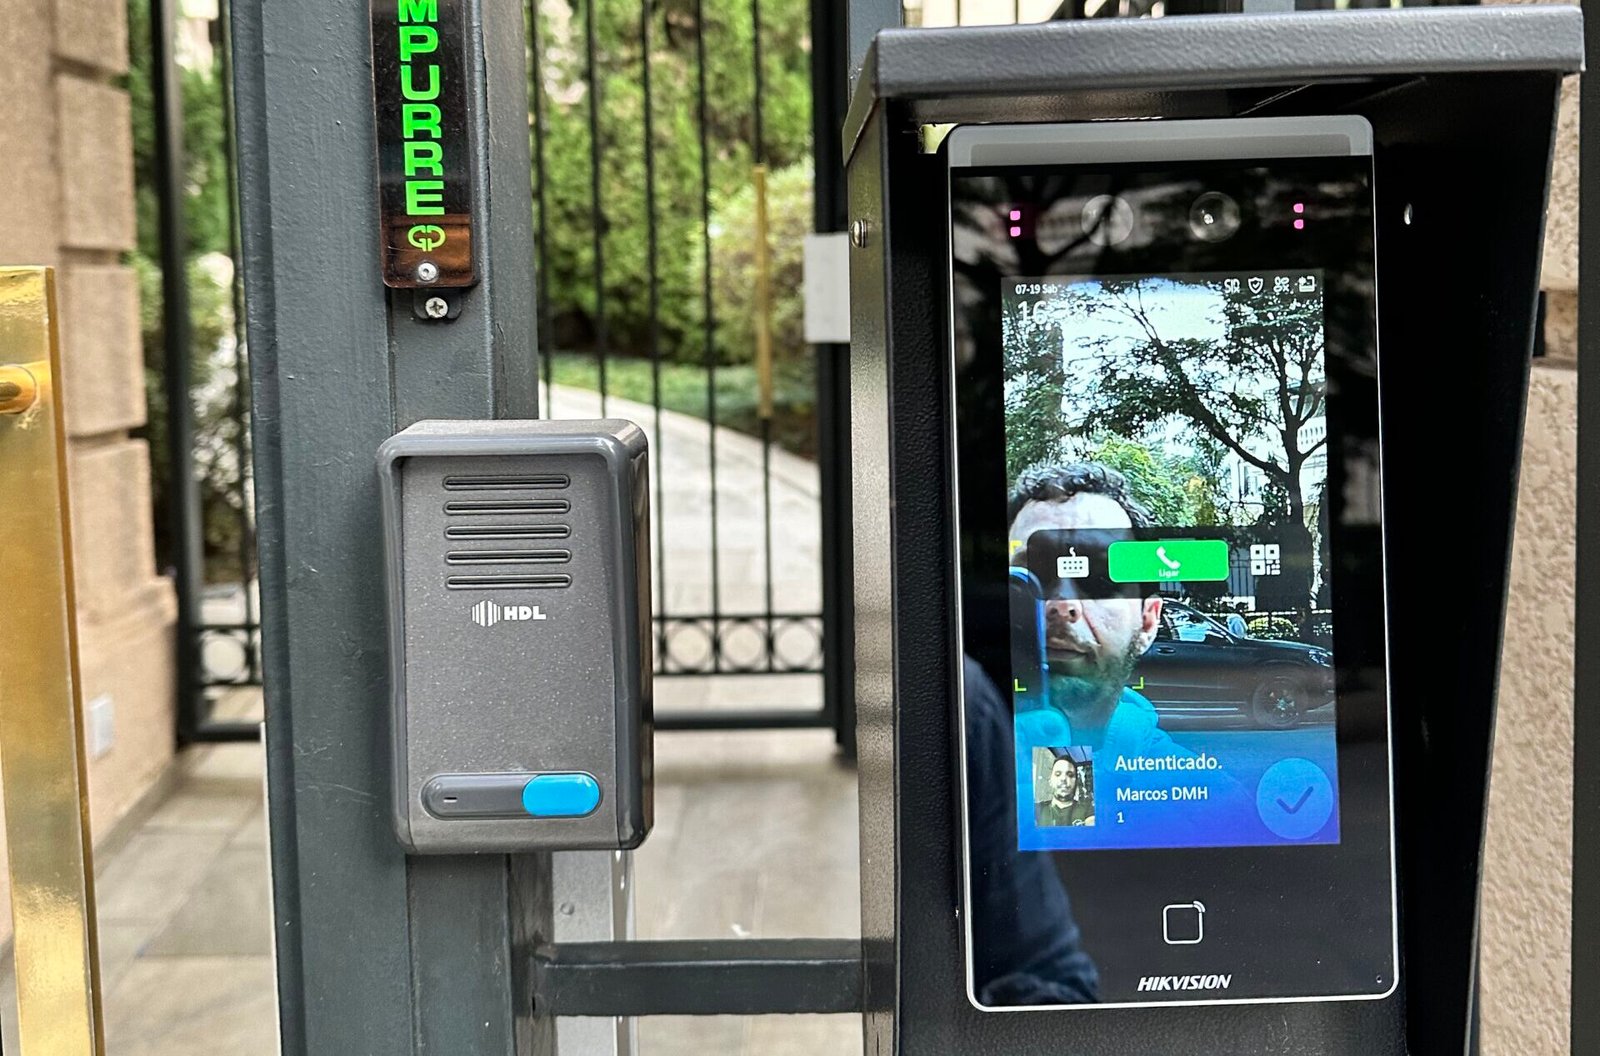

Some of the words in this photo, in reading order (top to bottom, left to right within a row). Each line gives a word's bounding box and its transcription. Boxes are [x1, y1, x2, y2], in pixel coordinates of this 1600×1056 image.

[1015, 284, 1040, 295] 07-19
[1042, 283, 1058, 294] Sab
[1158, 569, 1179, 579] Ligar
[503, 605, 547, 621] HDL
[1114, 752, 1223, 772] Autenticado.
[1116, 787, 1168, 802] Marcos
[1171, 786, 1208, 801] DMH
[1116, 811, 1125, 824] 1
[1137, 974, 1232, 992] HIKVISION
